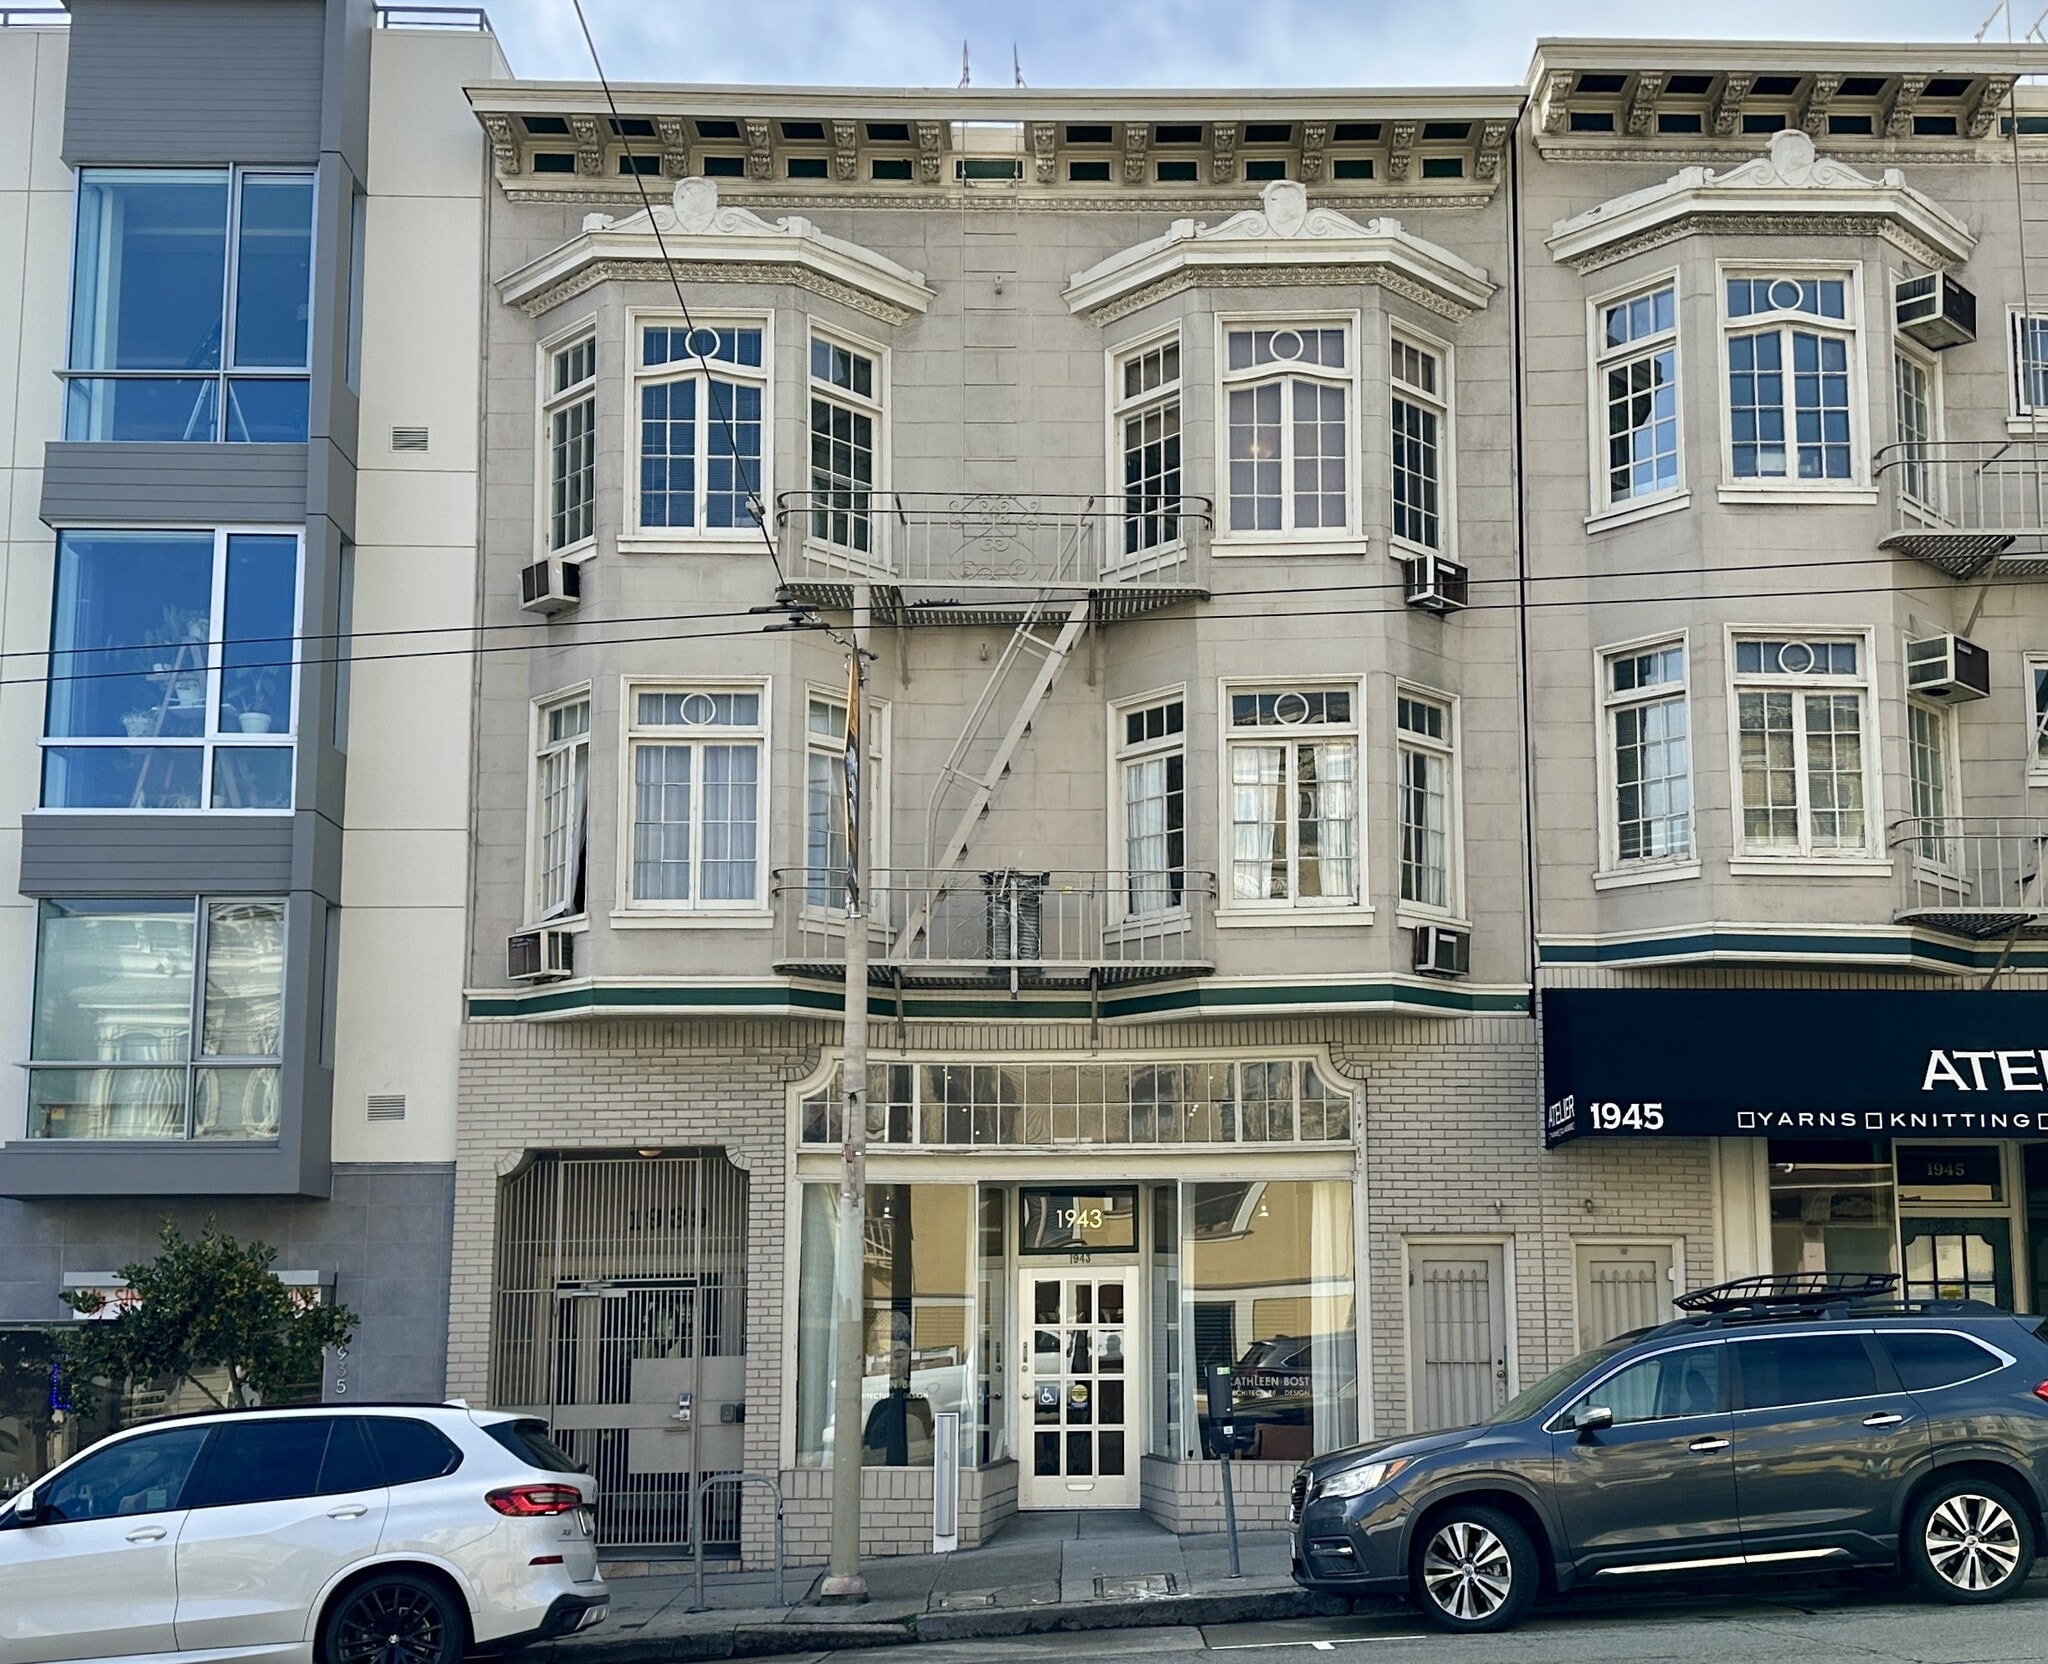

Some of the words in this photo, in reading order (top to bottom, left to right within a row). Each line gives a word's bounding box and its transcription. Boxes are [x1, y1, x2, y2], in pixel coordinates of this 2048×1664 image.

[1922, 1048, 2048, 1092] ATE
[1548, 1094, 1575, 1129] ATELIER
[1589, 1102, 1664, 1130] 1945
[1757, 1112, 1857, 1127] YARNS
[1890, 1112, 2032, 1128] KNITTING
[1926, 1162, 1966, 1177] 1945
[1056, 1208, 1103, 1229] 1943
[1070, 1253, 1092, 1265] 1943
[1283, 1376, 1310, 1387] BOST
[1284, 1389, 1310, 1397] DESIGN
